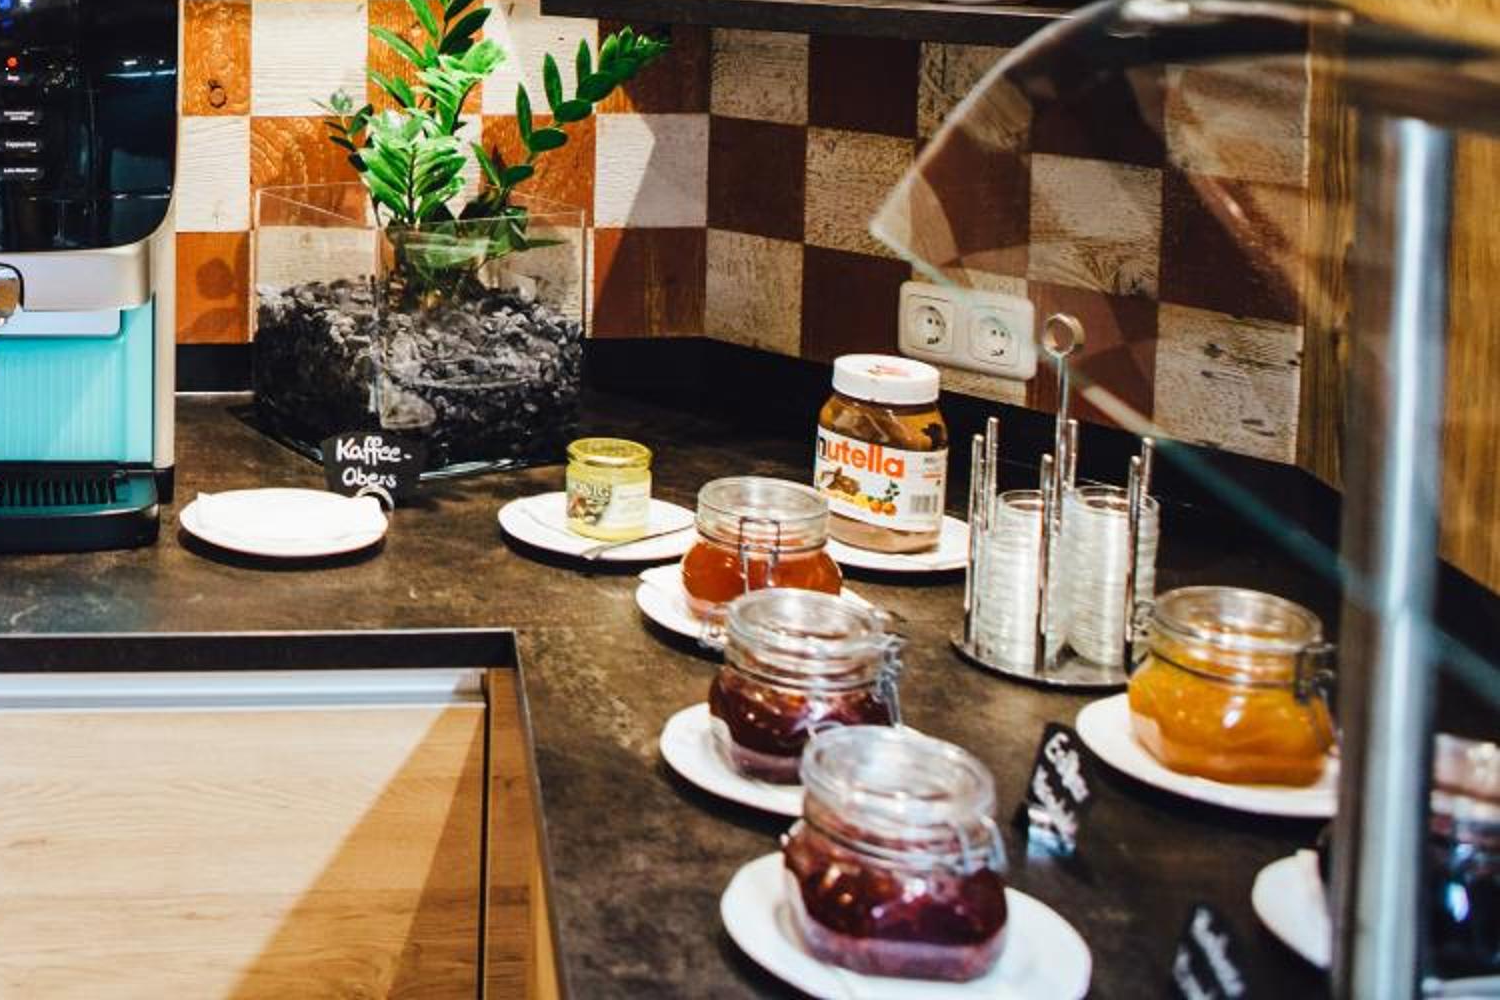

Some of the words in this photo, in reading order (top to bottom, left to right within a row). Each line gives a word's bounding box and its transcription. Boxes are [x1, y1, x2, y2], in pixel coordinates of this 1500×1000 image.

[336, 435, 413, 466] Kaffee-
[818, 436, 905, 479] nutella
[341, 465, 397, 489] Obers
